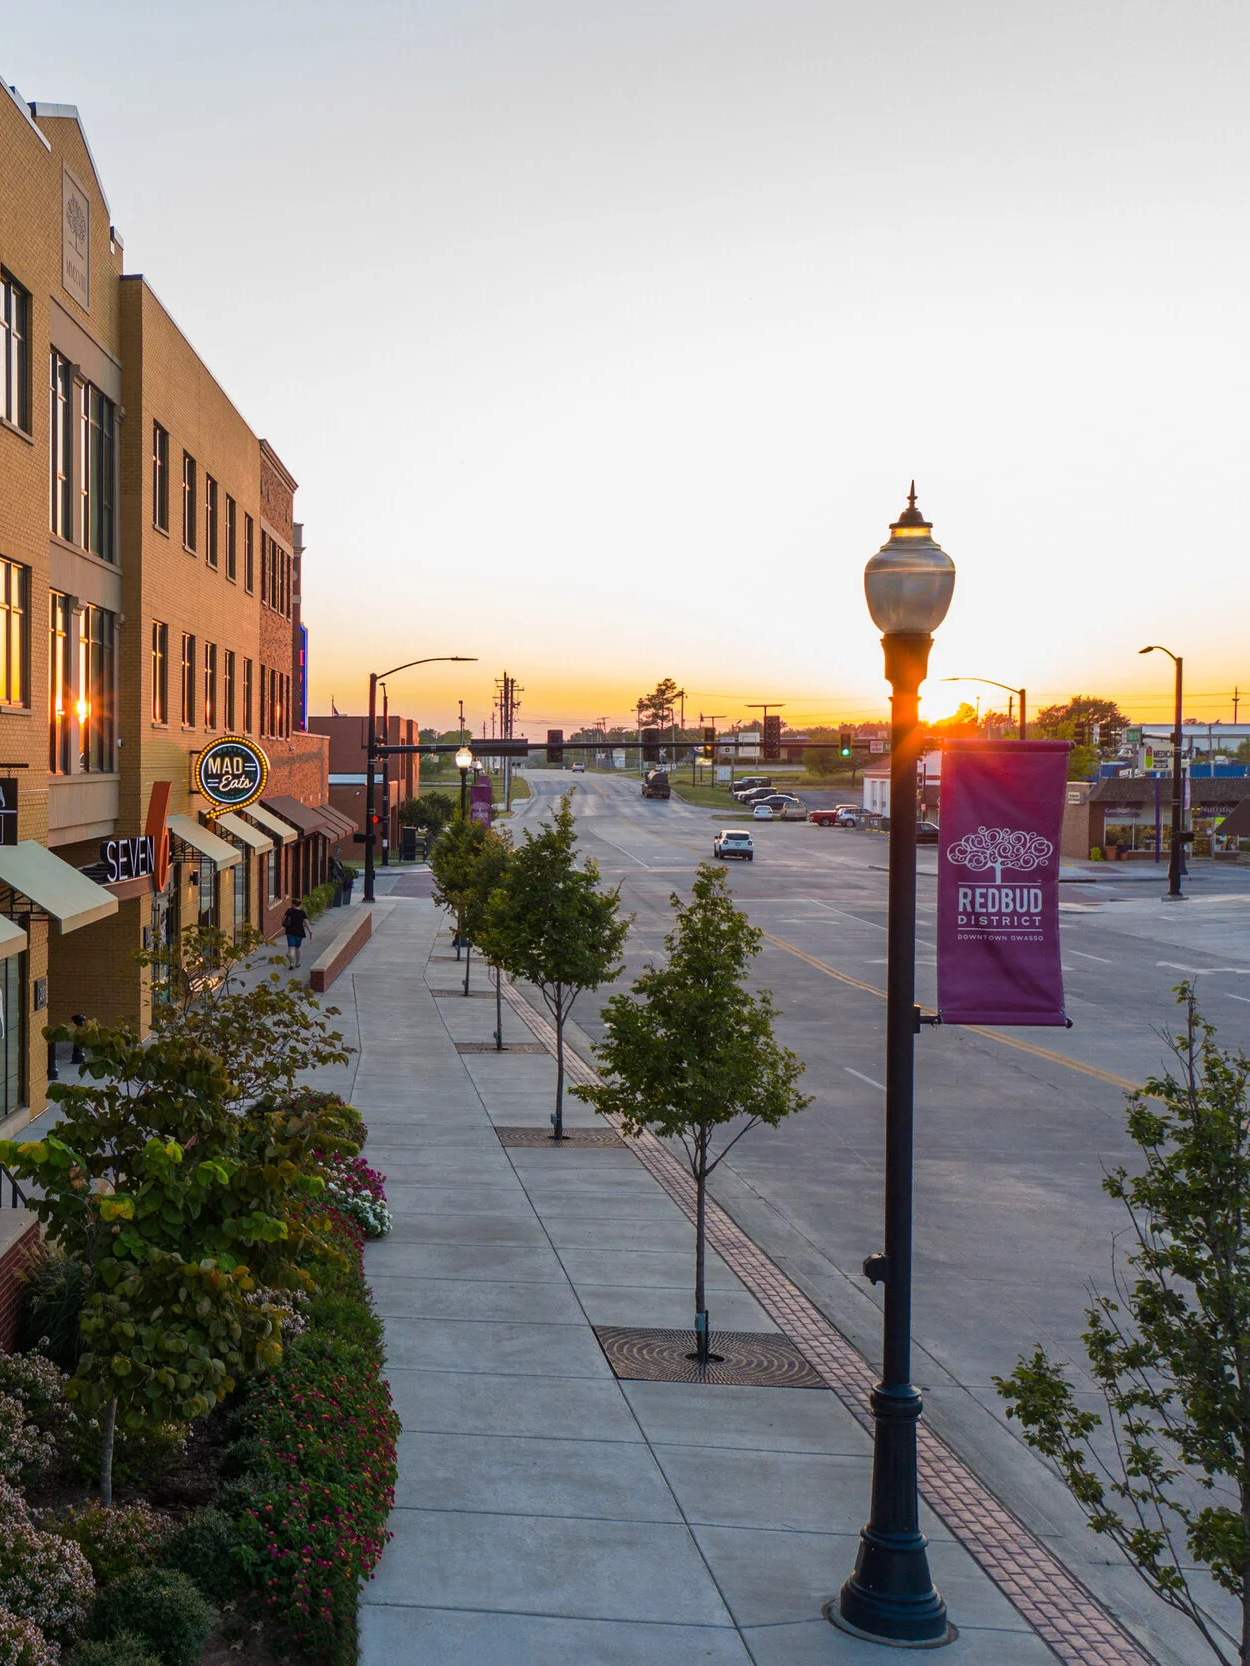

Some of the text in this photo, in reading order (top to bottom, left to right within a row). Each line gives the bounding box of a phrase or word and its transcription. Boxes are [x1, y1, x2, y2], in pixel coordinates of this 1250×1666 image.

[217, 747, 247, 756] MODERN
[208, 757, 243, 774] MAD
[219, 775, 253, 791] Eats
[144, 781, 173, 894] 6
[106, 835, 155, 883] SEVEN
[958, 887, 1042, 913] REDBUD
[958, 915, 1041, 926] DISTRICT
